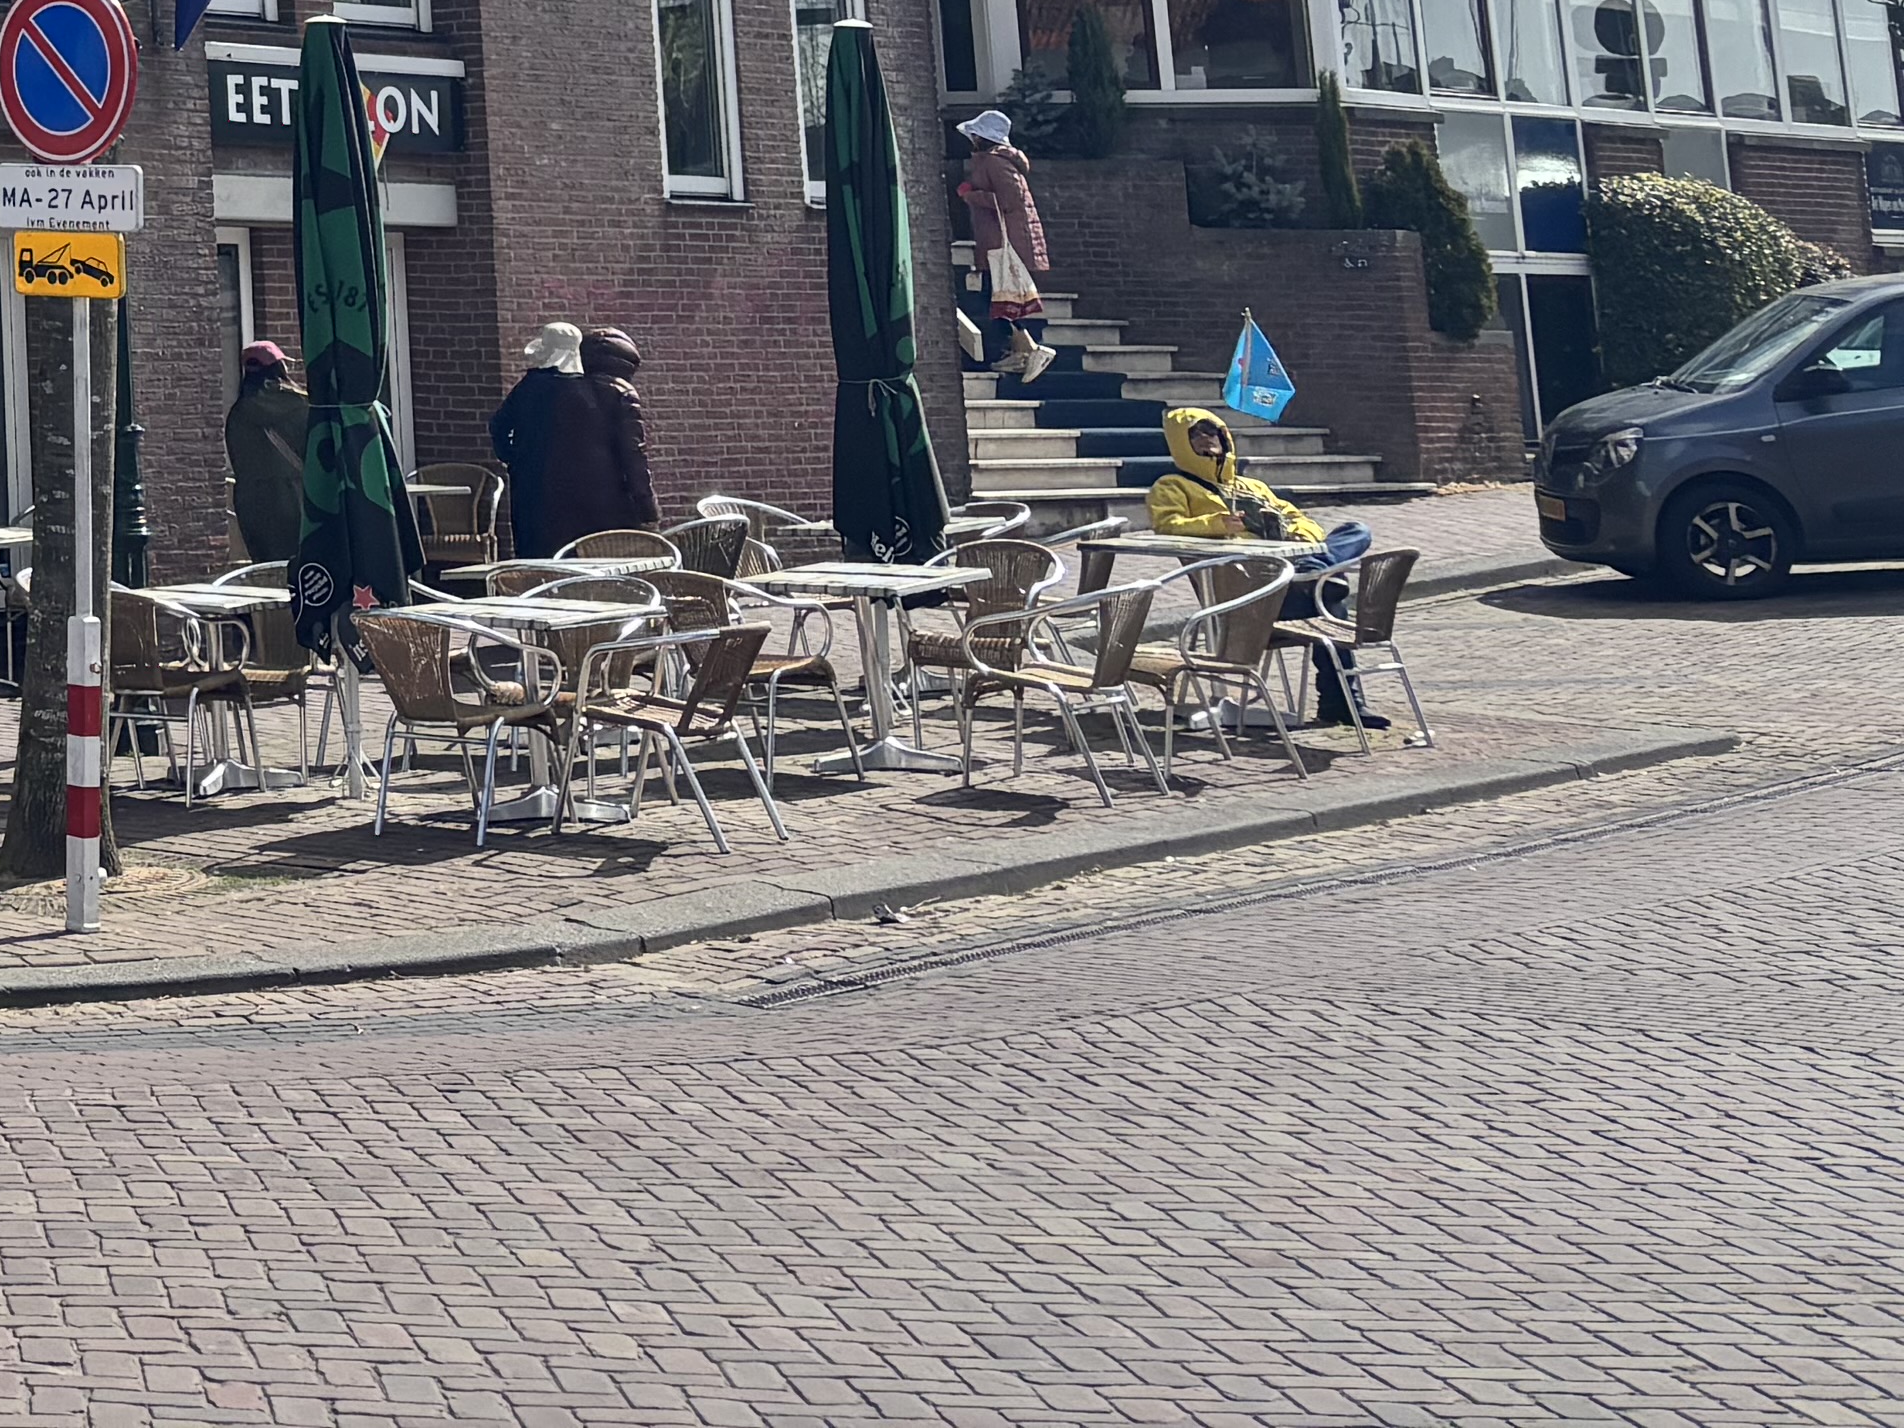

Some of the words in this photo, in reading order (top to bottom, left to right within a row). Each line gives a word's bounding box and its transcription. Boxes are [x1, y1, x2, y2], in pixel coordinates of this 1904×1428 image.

[226, 75, 439, 136] EETON
[25, 167, 42, 178] ook
[46, 167, 56, 178] in
[59, 167, 72, 178] de
[75, 167, 115, 179] vakken
[80, 189, 134, 214] April
[48, 217, 110, 230] Evenement
